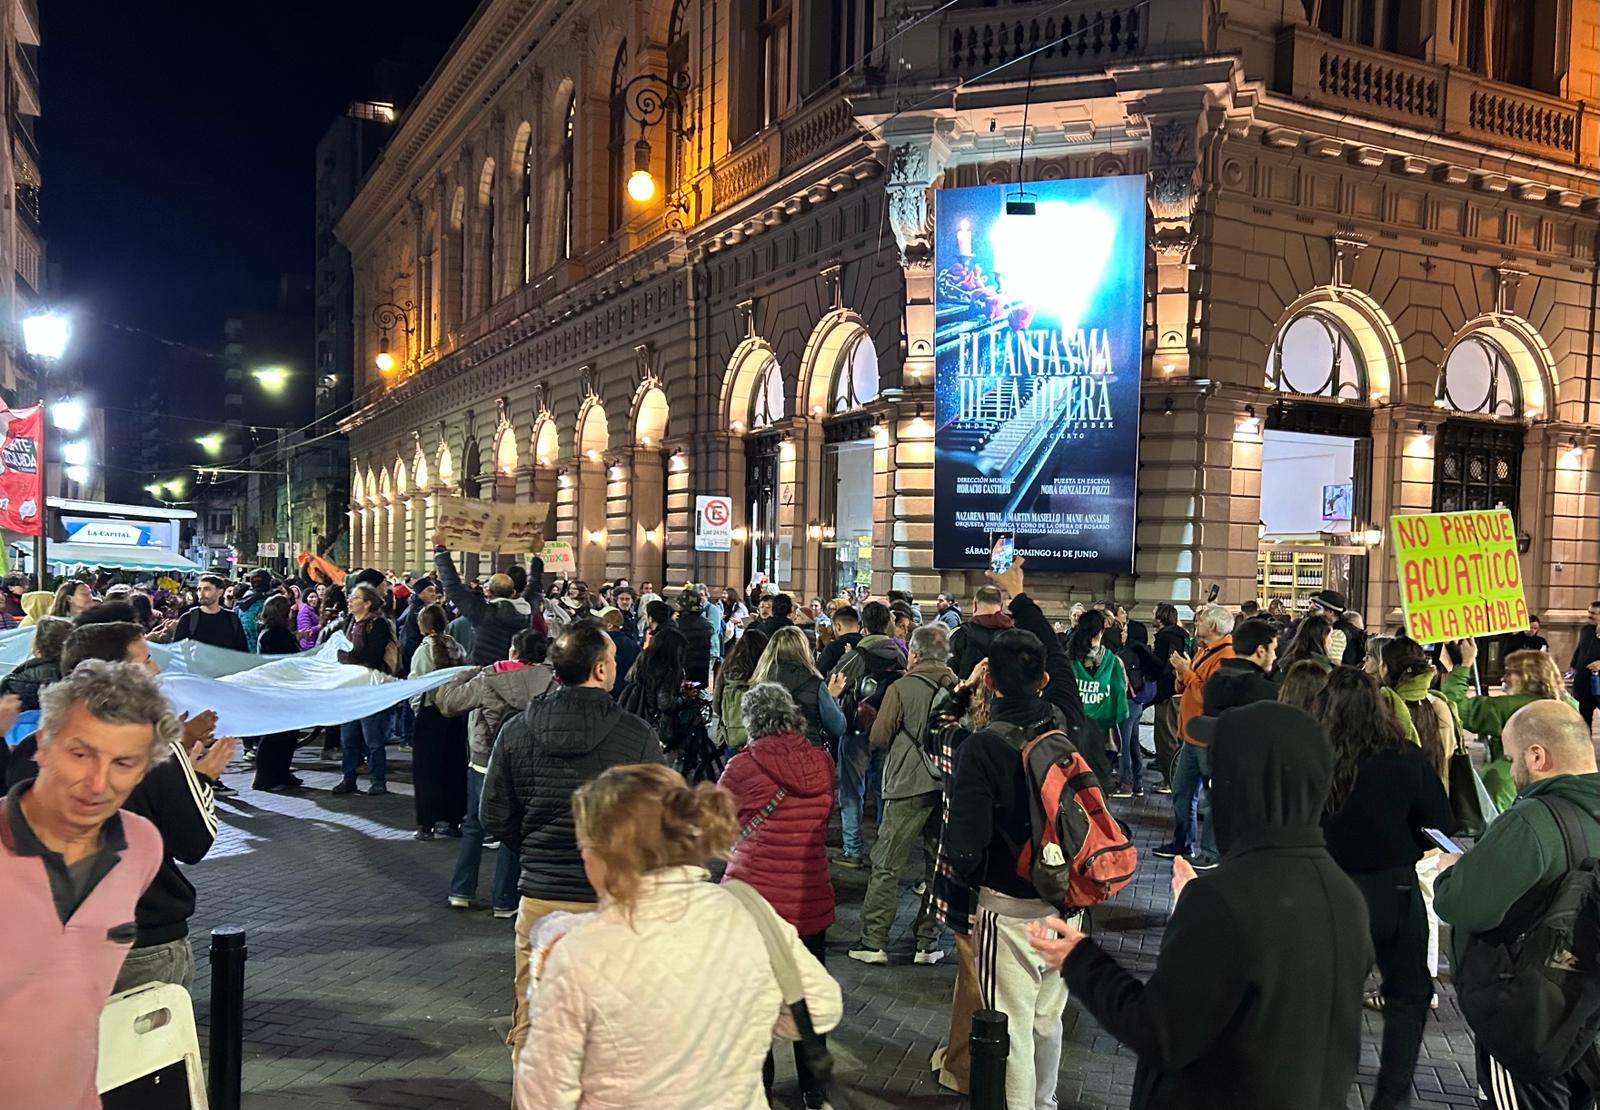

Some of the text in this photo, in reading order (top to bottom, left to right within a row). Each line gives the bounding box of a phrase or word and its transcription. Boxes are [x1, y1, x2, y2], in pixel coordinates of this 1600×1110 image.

[988, 328, 1114, 376] FANTASMA
[958, 376, 988, 422] DE
[957, 484, 982, 494] HORACIO
[1041, 484, 1057, 494] NORA
[1092, 486, 1110, 495] POZZI
[956, 512, 984, 521] NAZARENA
[985, 512, 1002, 521] VIDAL
[1398, 517, 1429, 549] NO
[1013, 549, 1051, 557] DOMINGO
[1074, 550, 1098, 559] JUNIO
[1410, 598, 1528, 640] EN LA RAMBLA
[1075, 678, 1100, 693] LLER
